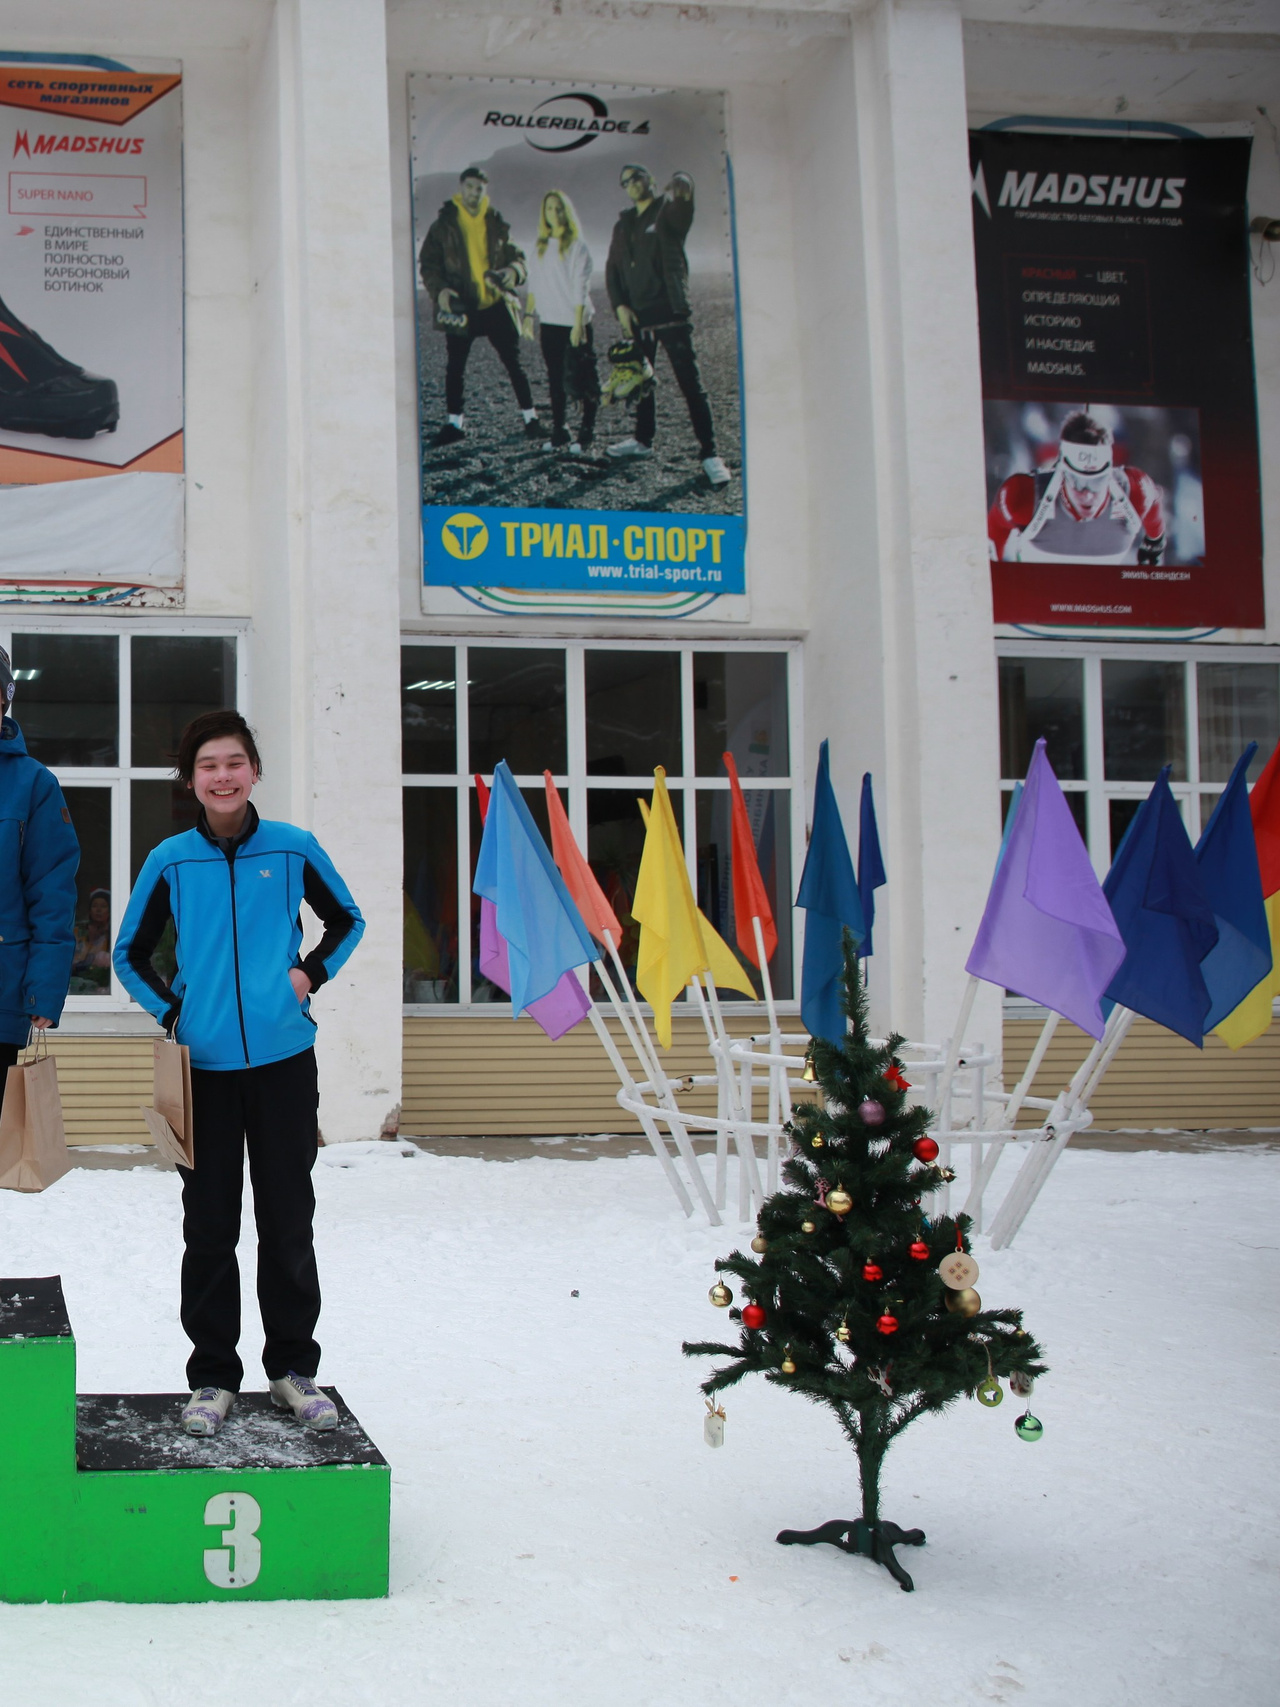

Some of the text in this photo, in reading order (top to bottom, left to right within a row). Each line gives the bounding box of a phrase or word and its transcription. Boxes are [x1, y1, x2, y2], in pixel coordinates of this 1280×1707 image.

[7, 80, 153, 94] сеть спортивных
[40, 94, 130, 106] магазинов
[483, 111, 631, 134] ROLLERBLADE
[33, 134, 144, 154] MADSHUS
[18, 189, 94, 202] SUPER NANO
[997, 170, 1186, 209] MADSHUS
[44, 226, 144, 239] ЕДИНСТВЕННЫЙ
[44, 240, 89, 251] В МИРЕ
[44, 253, 124, 266] ПОЛНОСТЬЮ
[44, 267, 130, 280] КАРБОНОВЫЙ
[44, 281, 103, 293] БОТИНОК
[1022, 290, 1120, 307] ОПРЕДЕЛЯЮЩИЙ
[1024, 314, 1082, 328] ИСТОРИЮ
[1025, 338, 1096, 352] И НАСЛЕДИЕ
[587, 563, 722, 583] www.trial-sport.ru
[204, 1491, 261, 1588] 3
